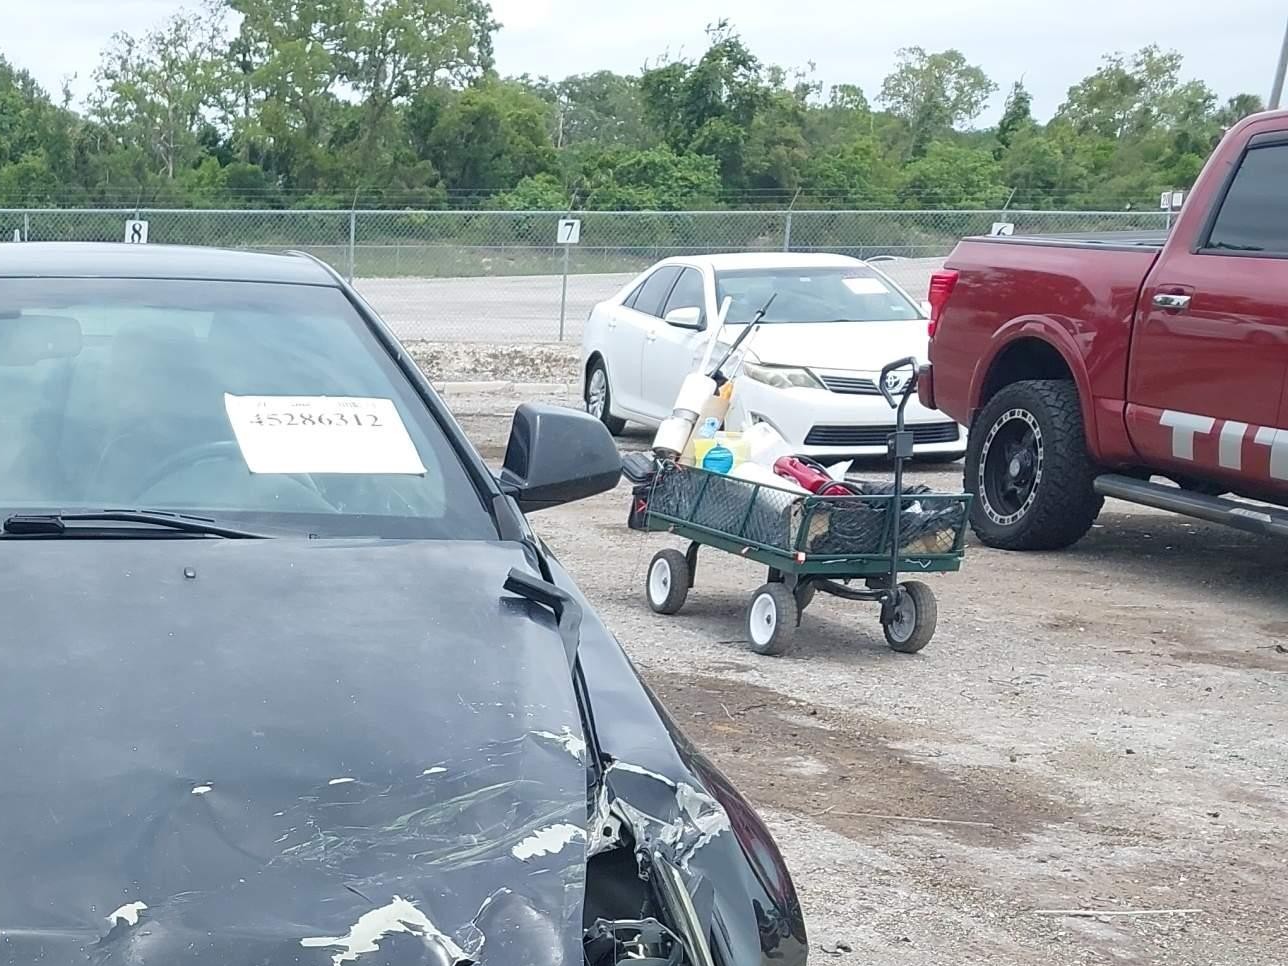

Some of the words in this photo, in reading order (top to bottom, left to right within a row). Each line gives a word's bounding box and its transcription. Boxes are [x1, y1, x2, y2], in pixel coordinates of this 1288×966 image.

[130, 222, 143, 244] 8
[564, 221, 576, 241] 7
[249, 411, 384, 428] 45286312
